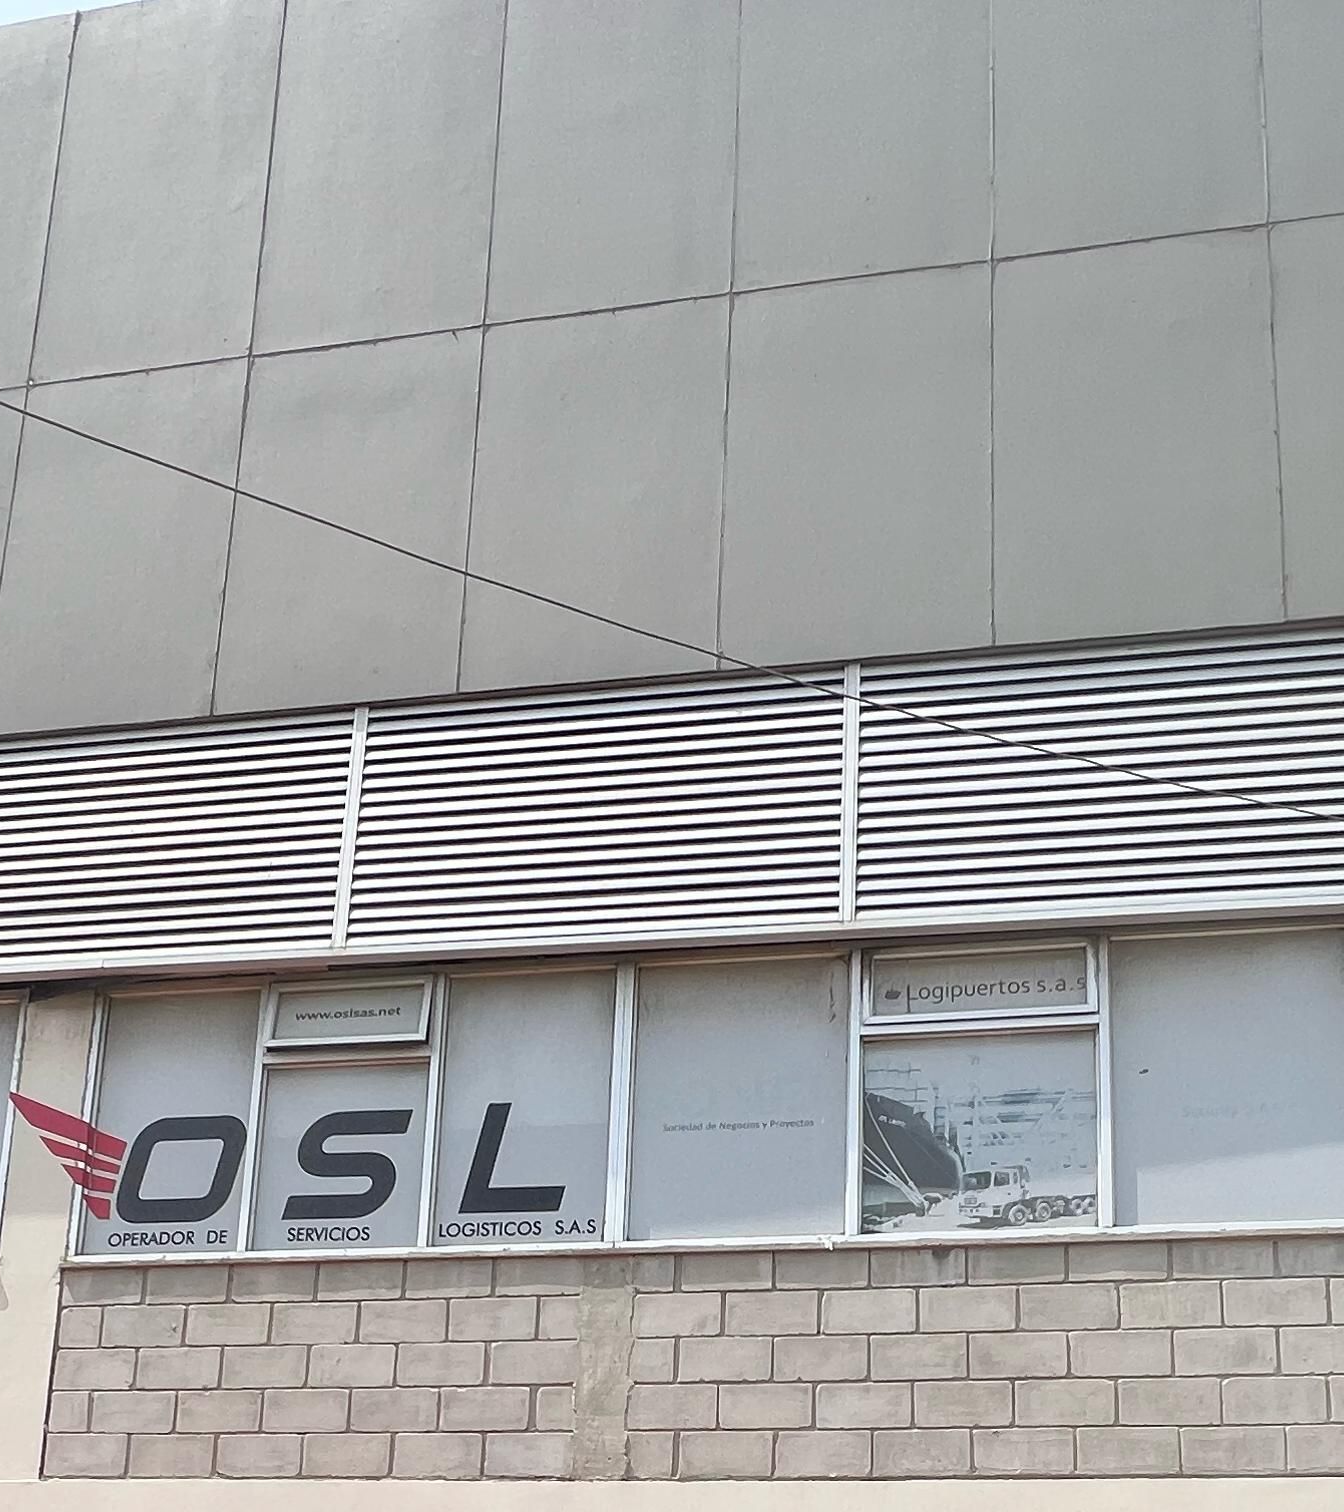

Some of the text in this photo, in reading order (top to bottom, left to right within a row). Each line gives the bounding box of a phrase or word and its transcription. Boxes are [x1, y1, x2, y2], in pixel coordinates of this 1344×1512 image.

[906, 980, 1031, 1004] Logipuertos
[295, 1007, 401, 1021] www.oslsas.net
[116, 1102, 566, 1223] OSL
[108, 1231, 195, 1247] OPERADOR
[206, 1230, 228, 1244] DE
[287, 1226, 370, 1241] SERVICIOS
[438, 1220, 542, 1238] LOGISTICOS
